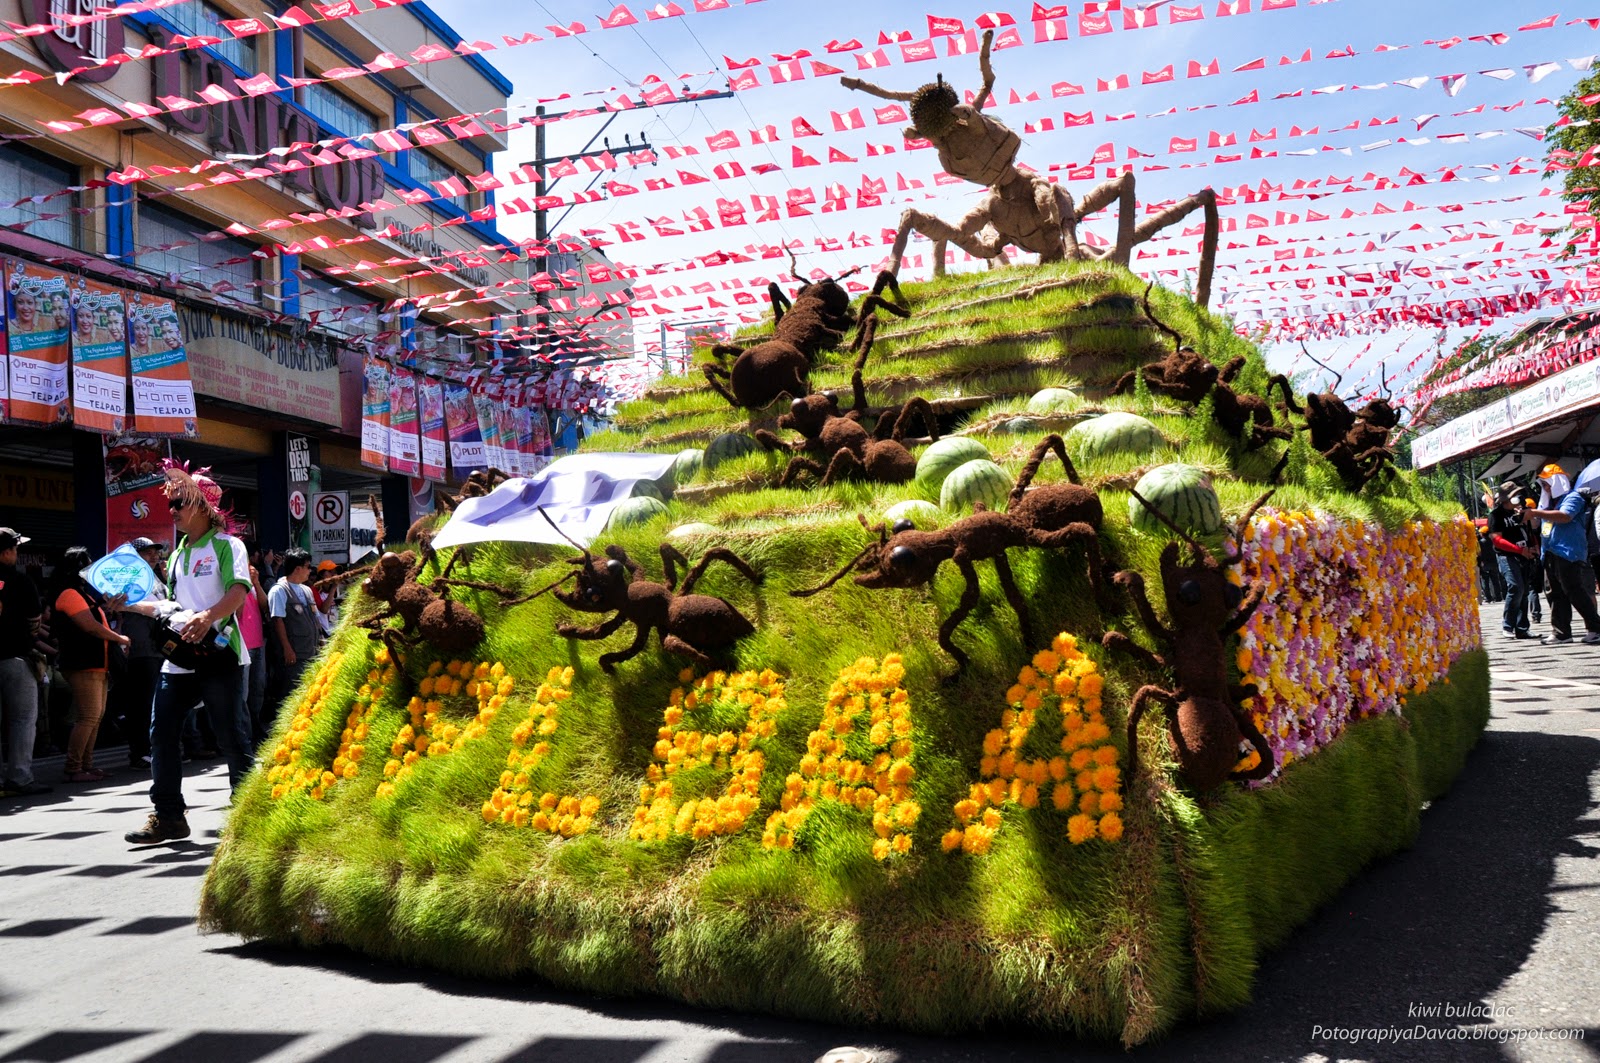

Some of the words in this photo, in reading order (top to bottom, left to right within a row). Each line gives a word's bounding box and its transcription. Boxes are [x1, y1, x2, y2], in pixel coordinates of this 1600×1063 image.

[181, 308, 215, 344] YOUR
[21, 361, 37, 369] PLDT
[187, 351, 226, 371] GROCERIES
[235, 363, 279, 385] KITCHENWARE
[15, 373, 64, 388] HOME
[80, 371, 95, 379] PLDT
[76, 382, 121, 399] HOME
[192, 379, 205, 392] OYS
[217, 386, 241, 400] SCHOOL
[193, 366, 242, 389] PLASTICWARE
[251, 382, 287, 400] APPLIANCES
[138, 391, 188, 402] HOME
[289, 437, 309, 452] LET'S
[462, 447, 482, 455] PLDT
[289, 450, 310, 468] DEW
[290, 467, 309, 482] THIS
[314, 530, 321, 541] NO
[323, 529, 345, 541] PARKING
[17, 553, 47, 566] NTRANCE
